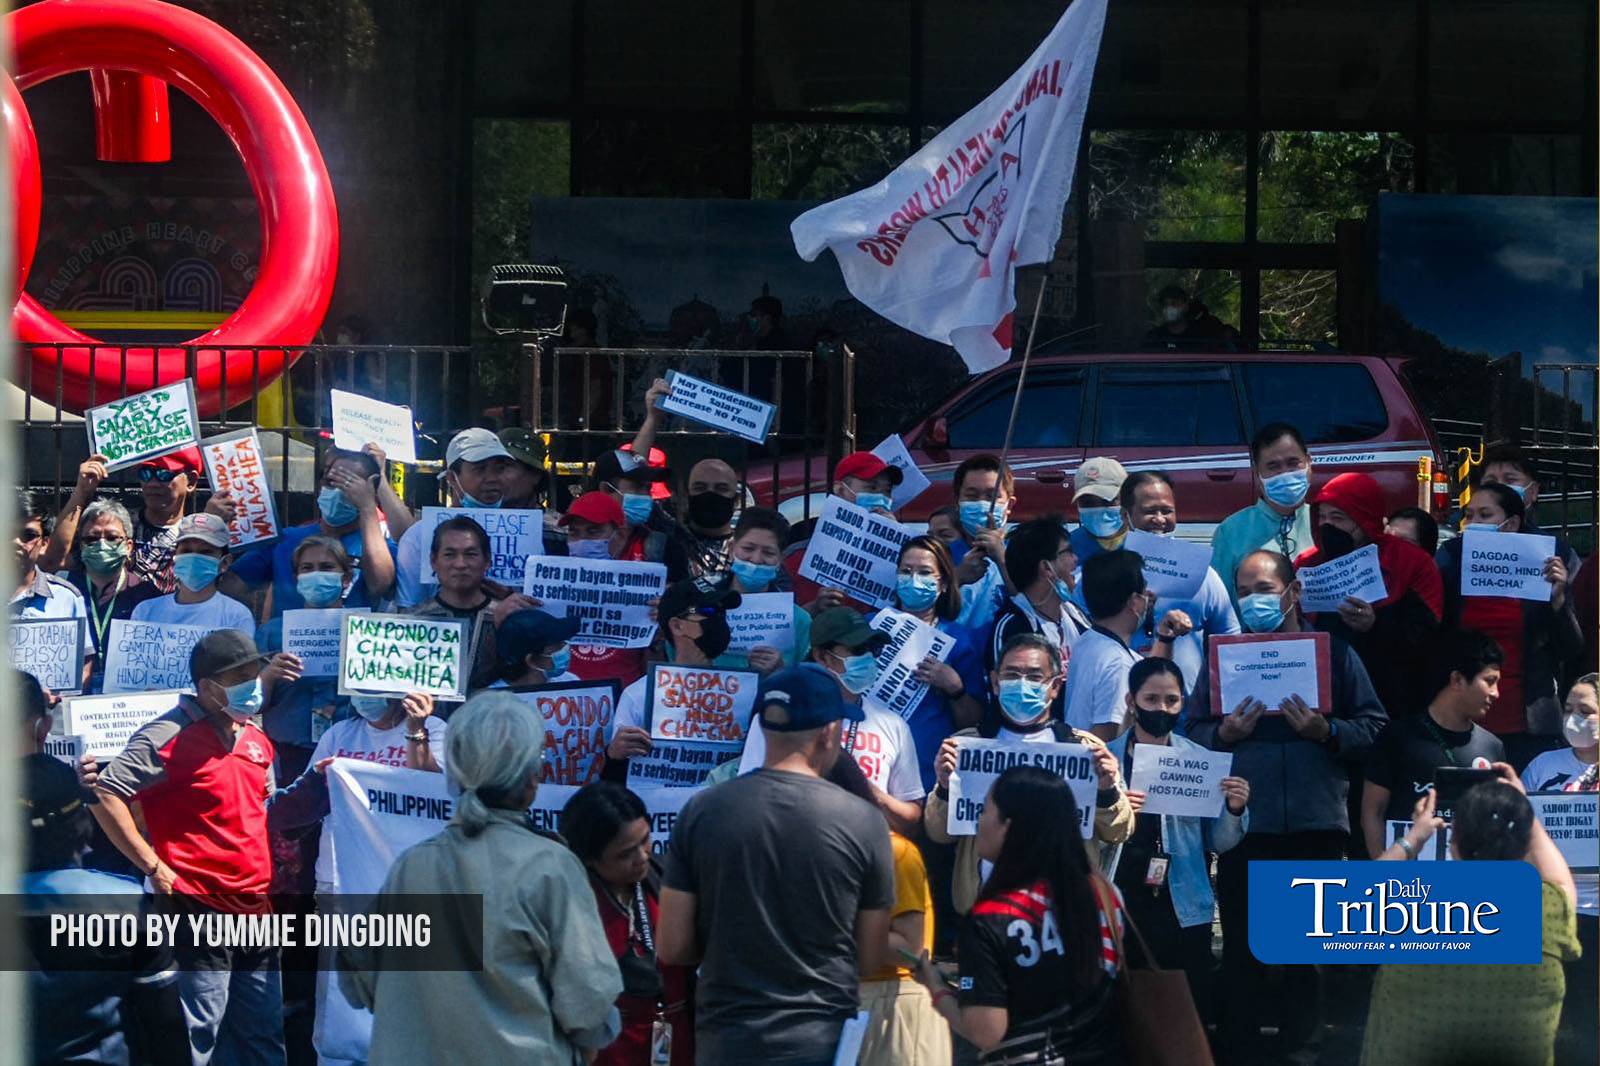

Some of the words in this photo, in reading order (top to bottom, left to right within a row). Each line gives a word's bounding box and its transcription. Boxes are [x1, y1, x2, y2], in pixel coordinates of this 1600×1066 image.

[146, 222, 225, 254] HEART
[677, 377, 699, 392] May
[108, 395, 151, 420] YES
[671, 384, 698, 400] Fund
[709, 397, 743, 416] Salary
[668, 394, 713, 414] Increase
[714, 408, 729, 421] NO
[731, 414, 758, 431] FUND
[111, 408, 188, 445] INCREASE
[1325, 454, 1376, 464] RUNNER
[866, 519, 911, 547] TRABAH
[835, 548, 874, 575] HINDI
[1470, 550, 1519, 562] DAGDAG
[535, 563, 561, 579] Pera
[563, 567, 579, 583] ng
[580, 566, 616, 586] bayan,
[618, 571, 661, 589] gamitin
[809, 553, 847, 582] Charter
[1470, 563, 1513, 575] SAHOD,
[1515, 566, 1545, 577] HIND
[1469, 577, 1524, 589] CHA-CHA!
[532, 584, 545, 598] sa
[546, 584, 600, 604] serbisyong
[566, 605, 603, 620] HINDI
[606, 608, 622, 621] sa
[122, 623, 165, 642] PERA
[288, 628, 328, 637] RELEASE
[349, 618, 383, 637] MAY
[385, 621, 440, 643] PONDO
[442, 626, 459, 643] SA
[592, 620, 654, 640] Change!
[749, 622, 774, 631] Public
[118, 640, 166, 657] GAMITIN
[356, 638, 455, 663] CHA-CHA
[1260, 650, 1280, 659] END
[347, 657, 395, 682] WALA
[413, 661, 456, 692] HEA
[1233, 661, 1307, 672] Contractualization
[117, 667, 148, 686] HINDI
[657, 668, 740, 695] DAGDAG
[875, 663, 910, 704] HINDI
[1260, 673, 1282, 681] Now!
[112, 702, 127, 710] END
[661, 687, 734, 713] SAHOD
[80, 710, 158, 722] CONTRACTUALIZATION
[658, 718, 744, 741] CHA-CHA
[662, 746, 679, 763] ng
[1157, 757, 1181, 768] HEA
[1183, 759, 1210, 771] WAG
[630, 761, 644, 777] sa
[1160, 771, 1204, 784] GAWING
[1147, 784, 1211, 799] HOSTAGE!!!
[367, 787, 453, 821] PHILIPPINE
[1542, 803, 1572, 814] SAHOD!
[1006, 909, 1065, 968] 34
